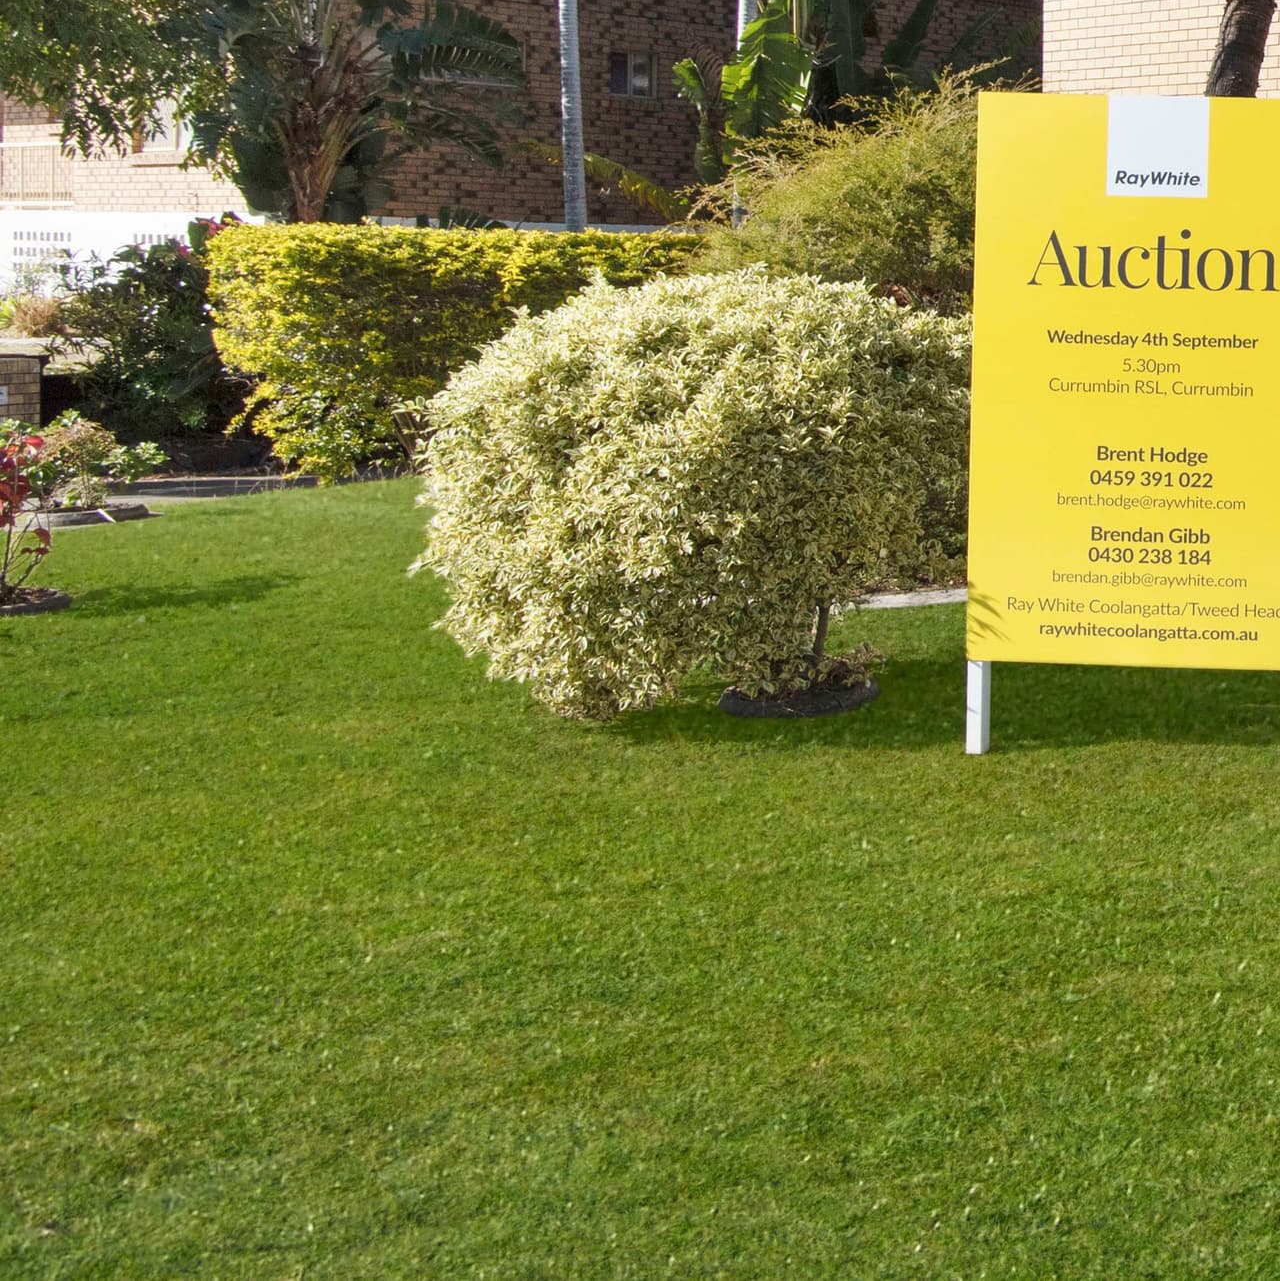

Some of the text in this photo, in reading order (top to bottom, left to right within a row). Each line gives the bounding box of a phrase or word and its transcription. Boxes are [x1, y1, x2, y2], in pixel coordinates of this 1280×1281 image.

[1027, 229, 1280, 292] Auction
[1047, 329, 1259, 350] Wednesday 4th September
[1122, 358, 1181, 375] 5.30pm
[1049, 377, 1254, 397] Currumbin RSL, Currumbin
[1096, 445, 1208, 465] Brent Hodge
[1090, 470, 1213, 488] 0459 391 022
[1057, 493, 1245, 510] brent.hodge@raywhite.com
[1091, 526, 1210, 544] Brendan Gibb
[1088, 547, 1212, 565] 0430 238 184
[1052, 570, 1247, 588] brendan.gibb@raywhite.com
[1007, 596, 1034, 614] Ray
[1038, 597, 1084, 613] White
[1089, 598, 1239, 619] Coolangatta/Tweed
[1039, 621, 1258, 642] raywhitecoolangatta.com.au
